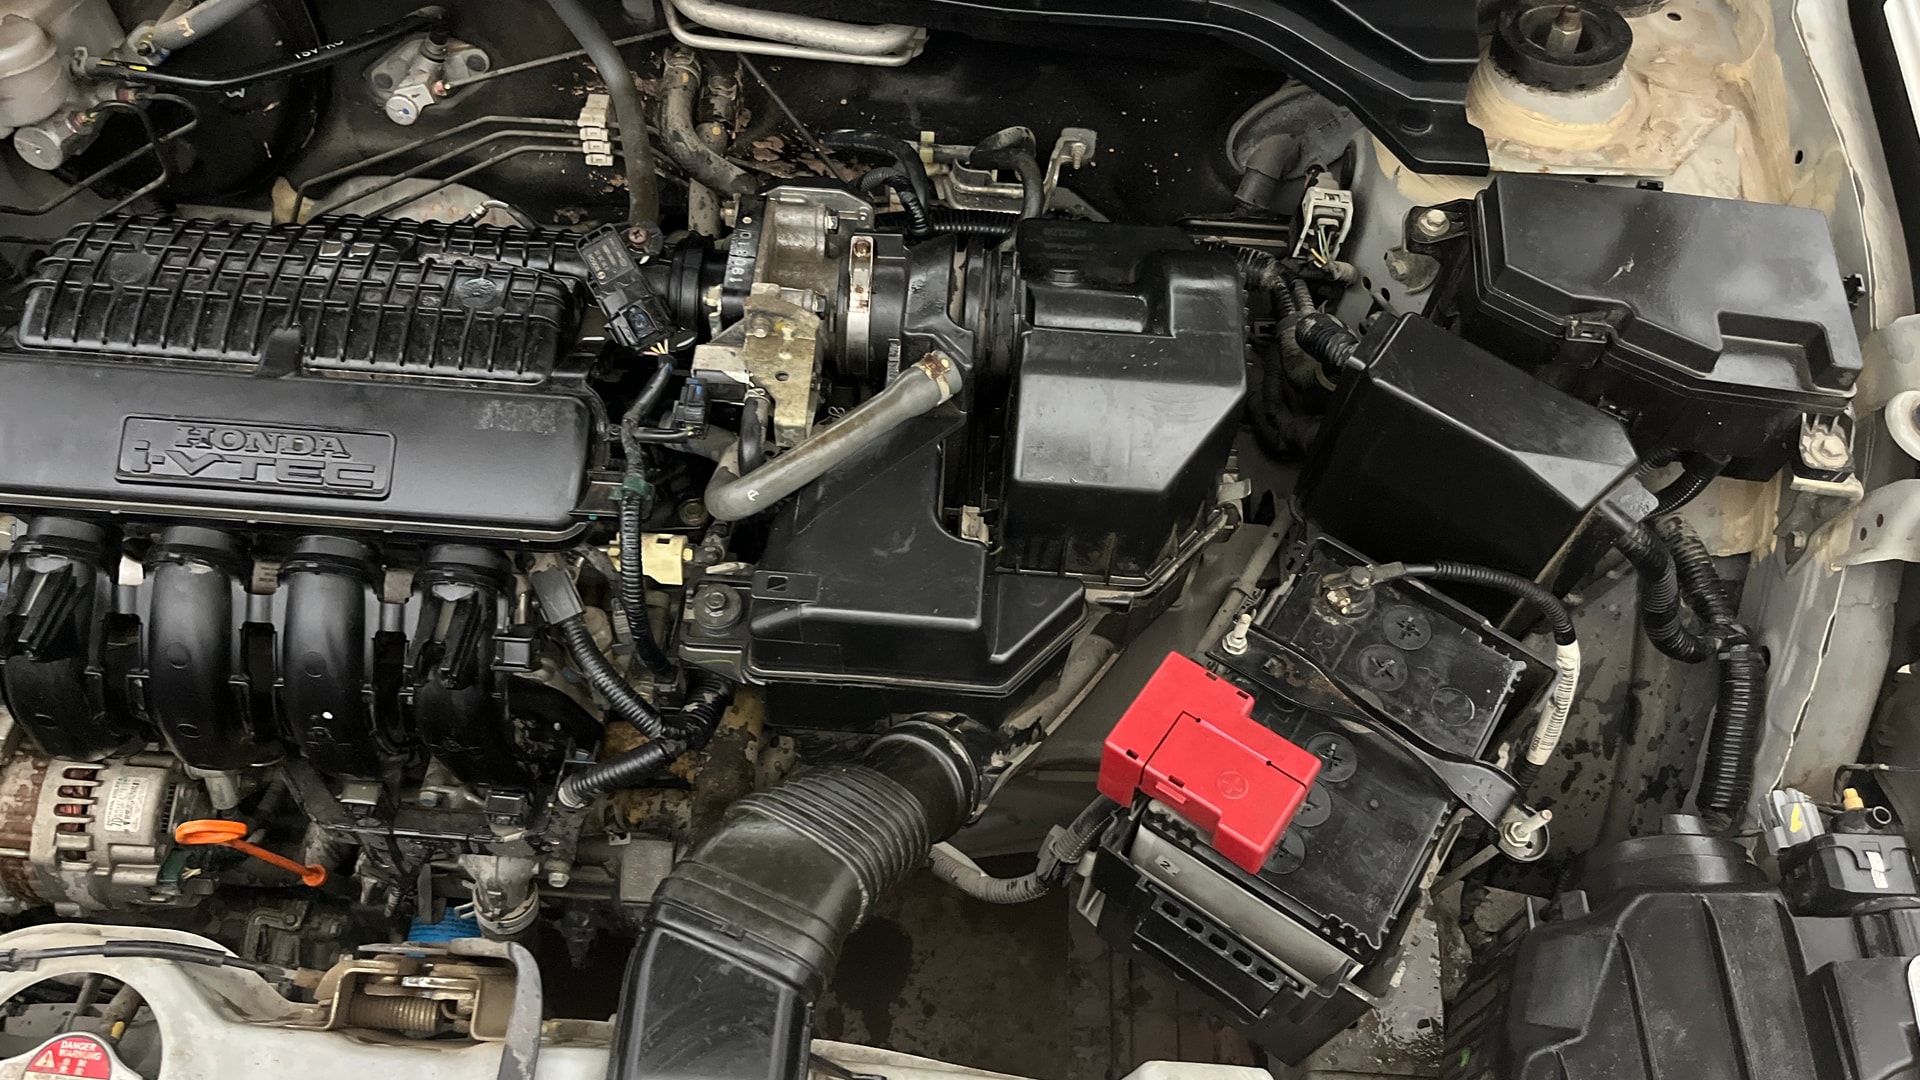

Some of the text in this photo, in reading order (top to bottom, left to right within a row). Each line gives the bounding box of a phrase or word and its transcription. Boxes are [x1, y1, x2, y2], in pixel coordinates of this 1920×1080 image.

[174, 425, 351, 458] HONDA
[130, 440, 375, 488] i-VTEC
[60, 1040, 97, 1051] DANGER
